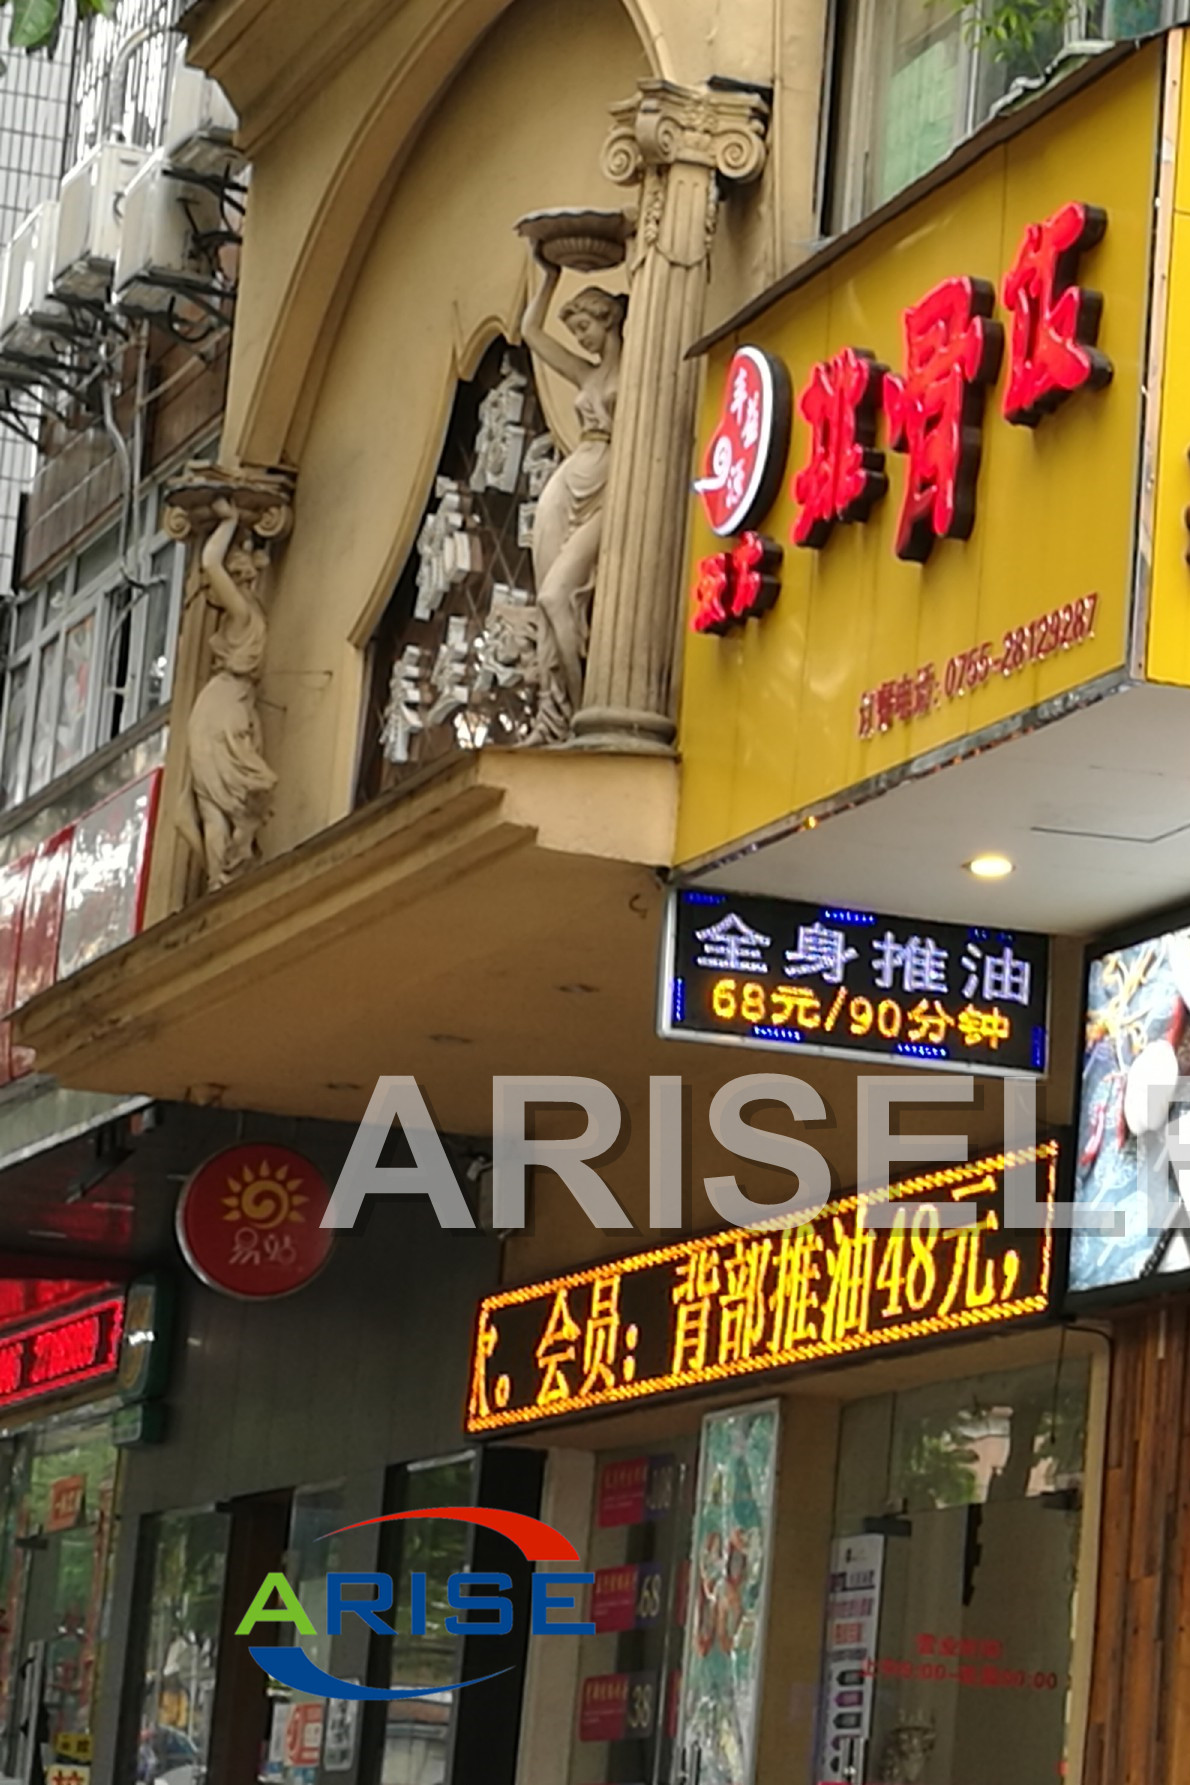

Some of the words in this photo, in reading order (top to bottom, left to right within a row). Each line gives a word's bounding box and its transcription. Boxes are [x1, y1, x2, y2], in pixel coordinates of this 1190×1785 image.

[694, 911, 1032, 1006] 全身推油
[710, 977, 1011, 1050] 68元/90分钟
